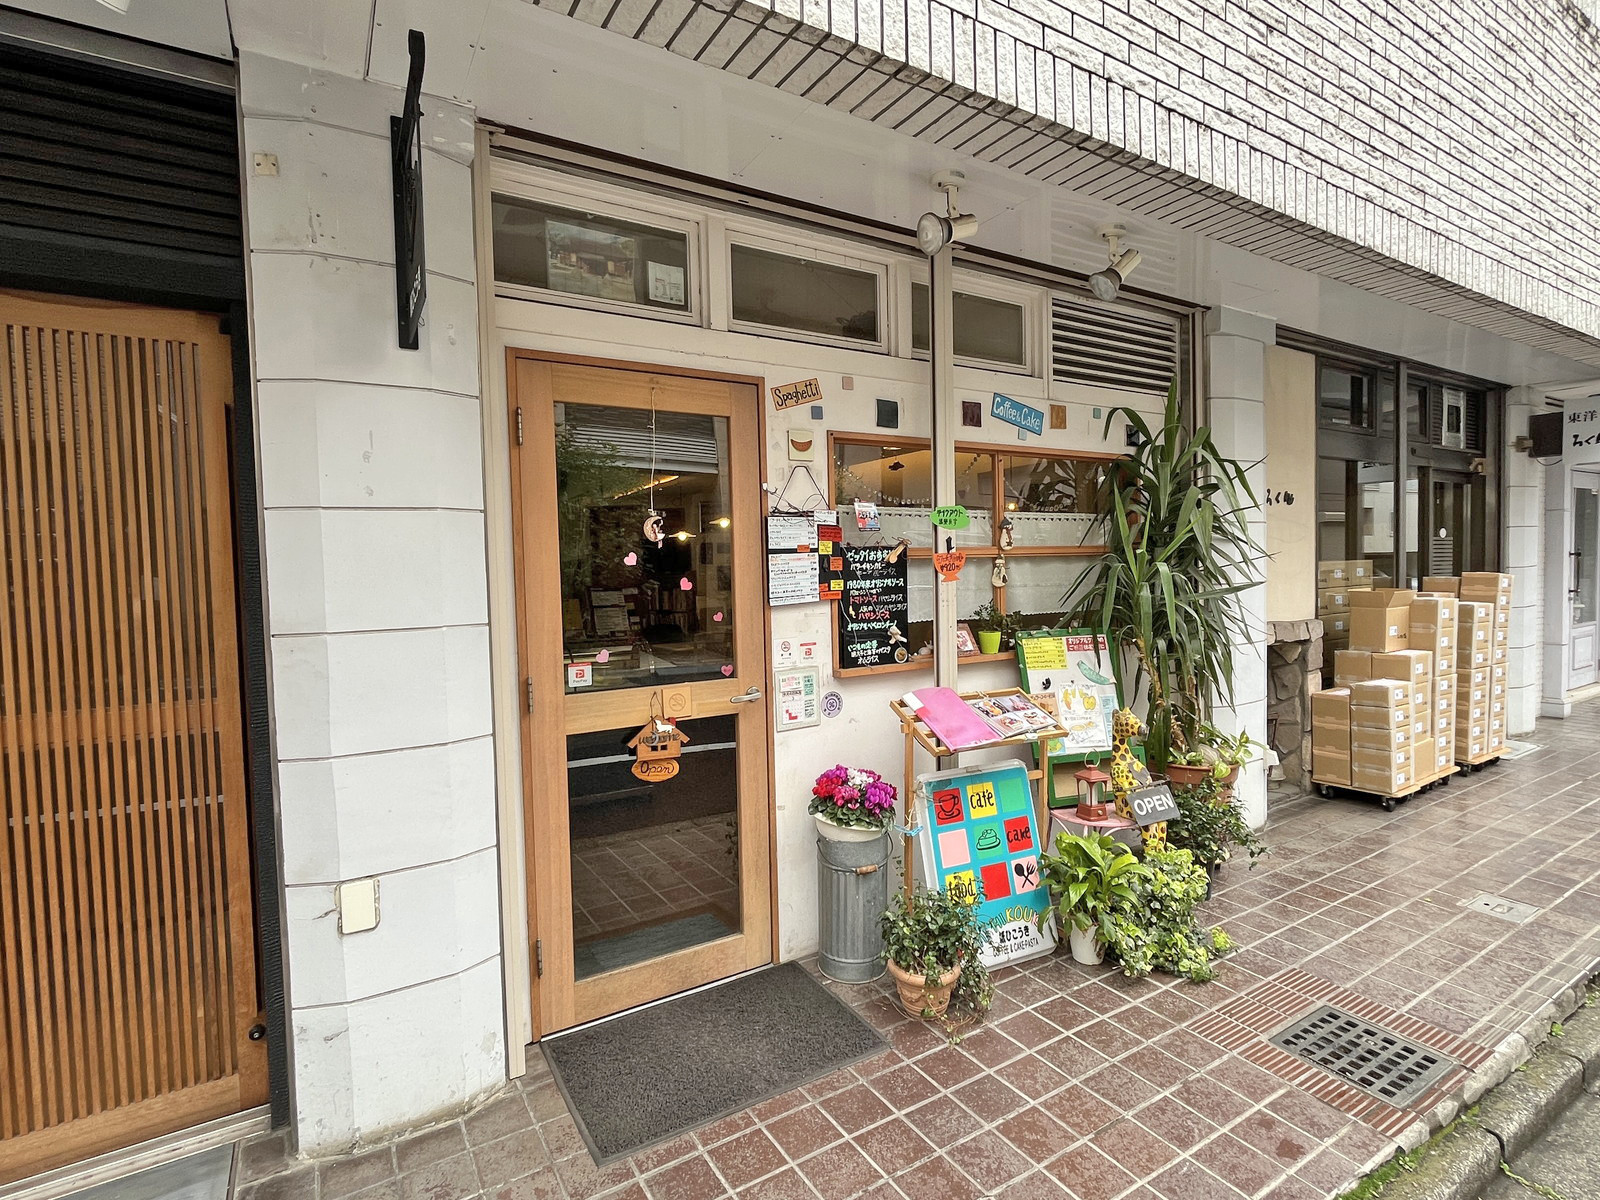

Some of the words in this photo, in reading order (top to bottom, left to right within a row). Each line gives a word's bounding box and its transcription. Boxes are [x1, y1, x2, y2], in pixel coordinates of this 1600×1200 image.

[774, 381, 819, 407] Spaghetti
[850, 595, 878, 604] トマトソース
[858, 611, 890, 620] ハヤシソース
[640, 761, 675, 776] Open
[1134, 793, 1175, 816] OPEN
[1007, 826, 1031, 843] cake
